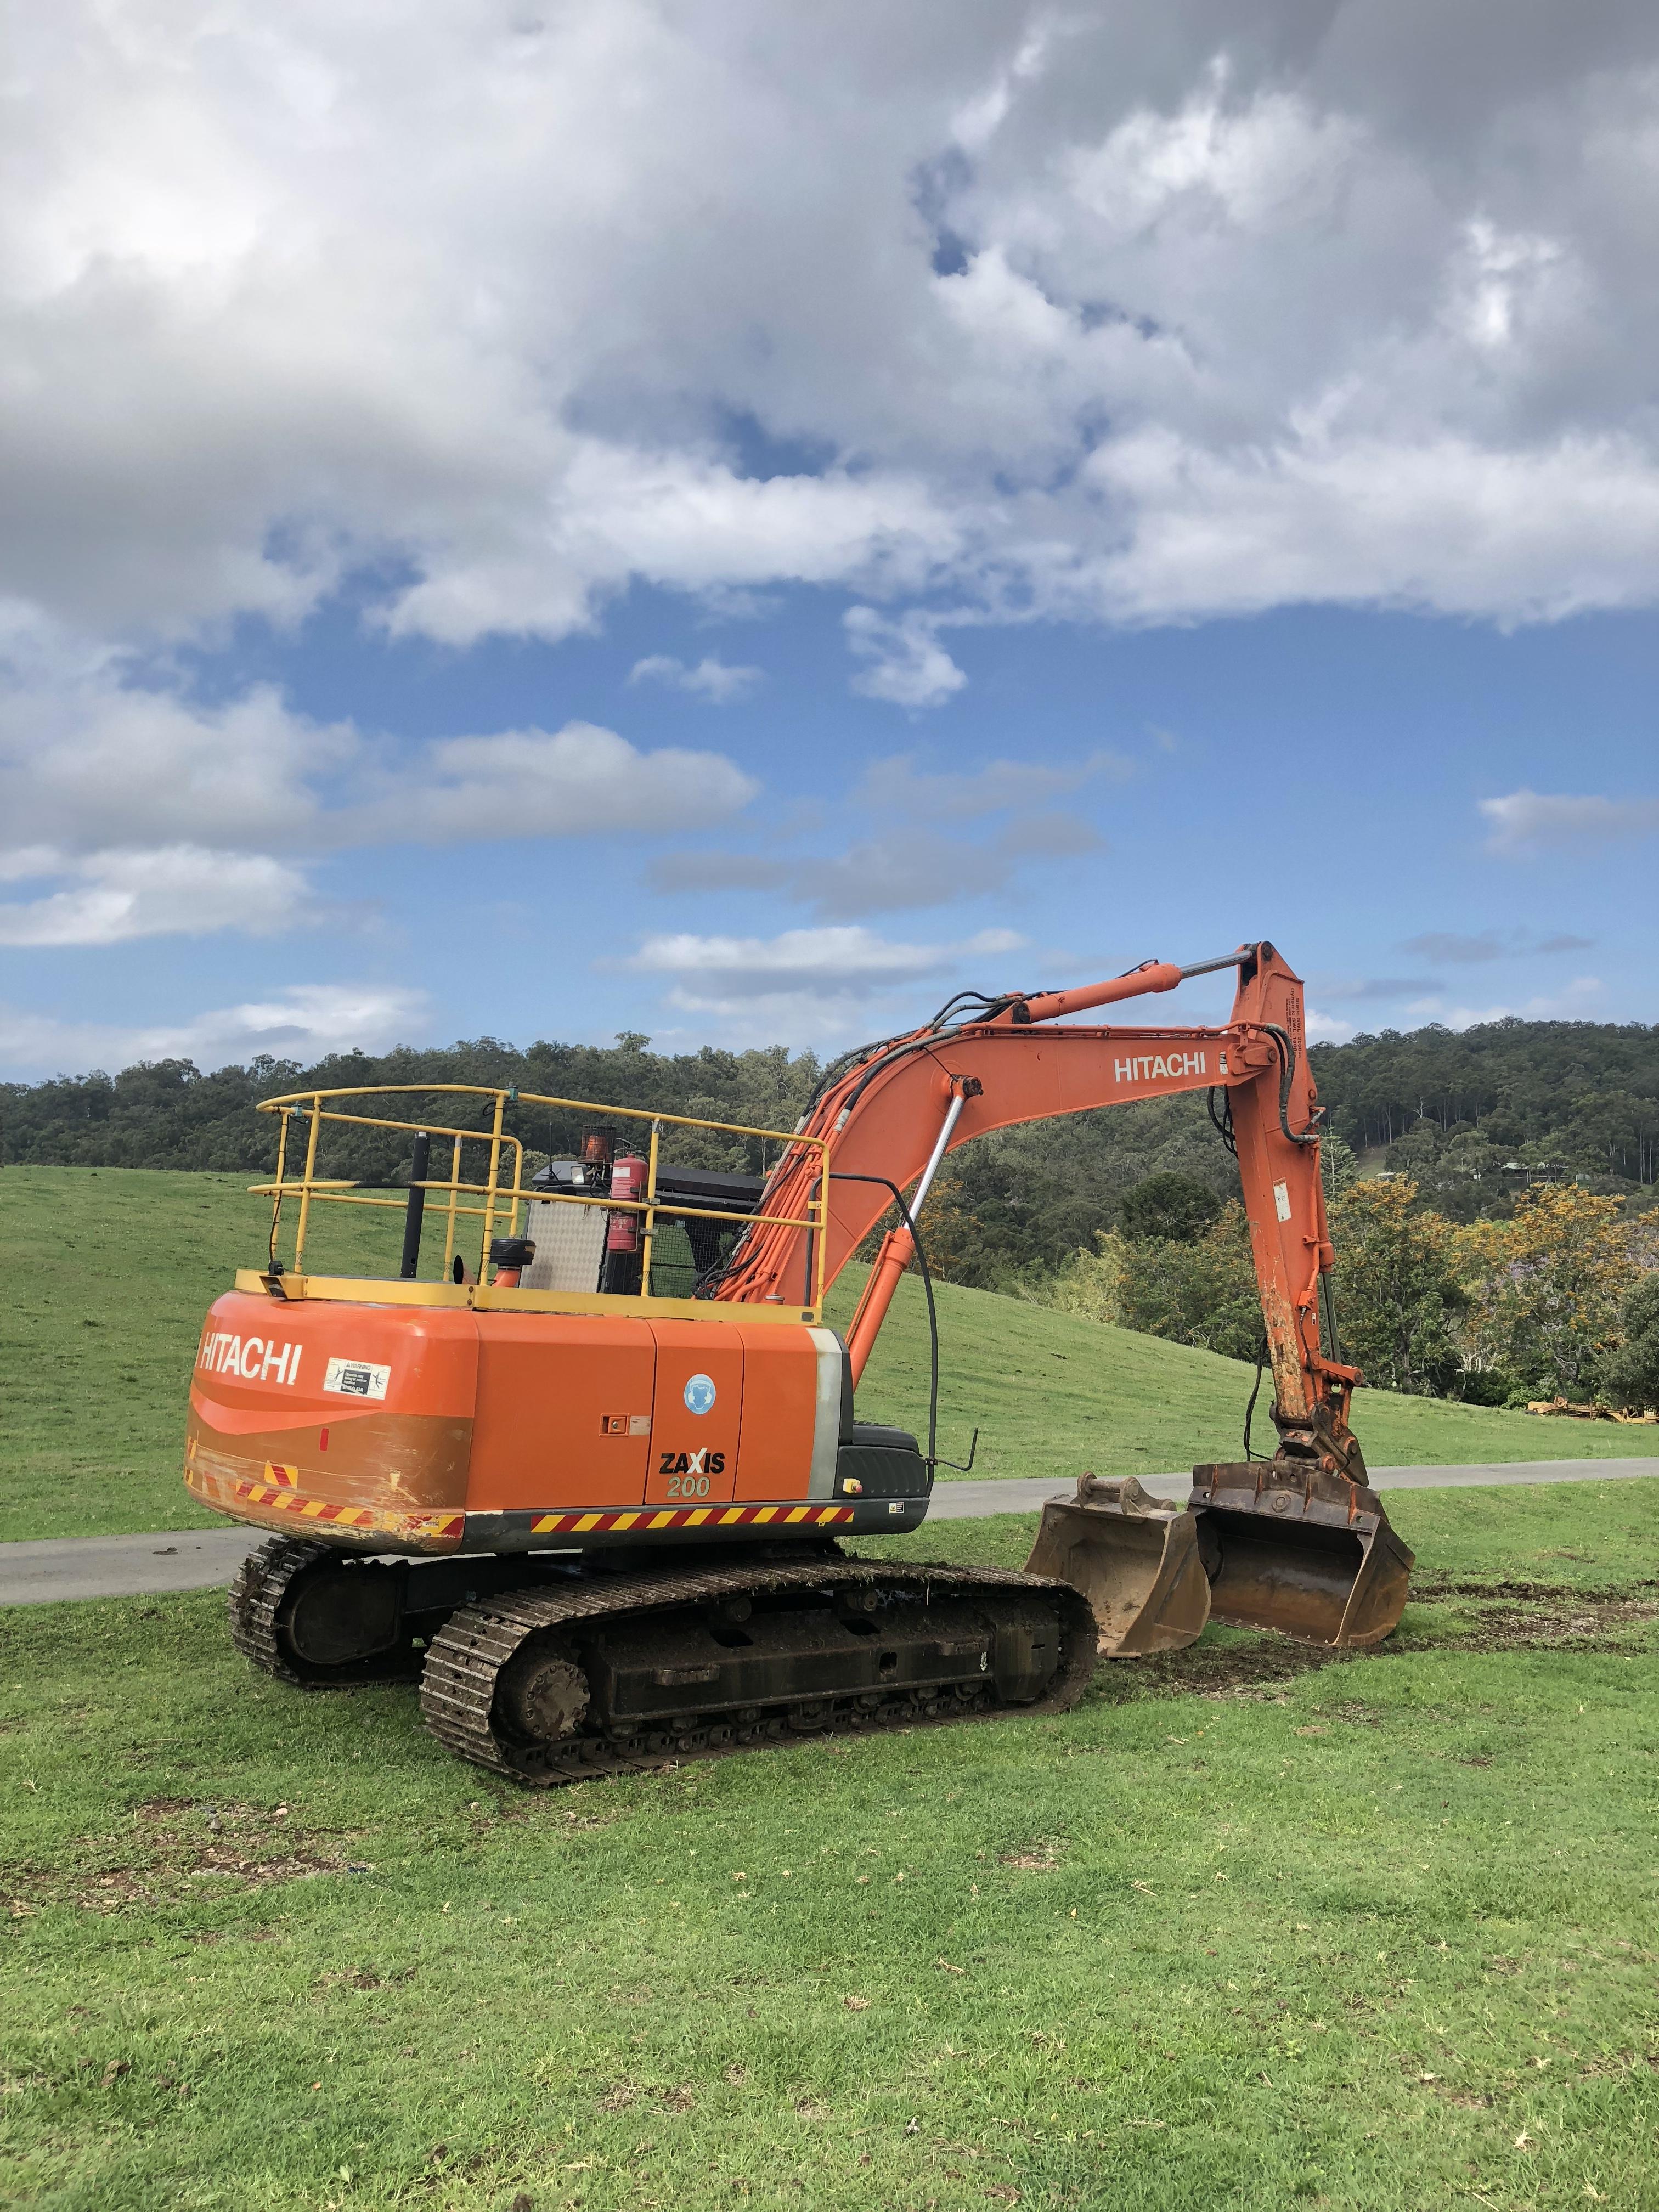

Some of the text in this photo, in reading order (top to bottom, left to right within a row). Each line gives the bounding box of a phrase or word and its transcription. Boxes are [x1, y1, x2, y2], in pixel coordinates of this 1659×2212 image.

[1114, 1051, 1206, 1082] HITACHI
[200, 1331, 303, 1386] HITACHI
[659, 1447, 725, 1474] ZAXIS
[667, 1476, 710, 1497] 200
